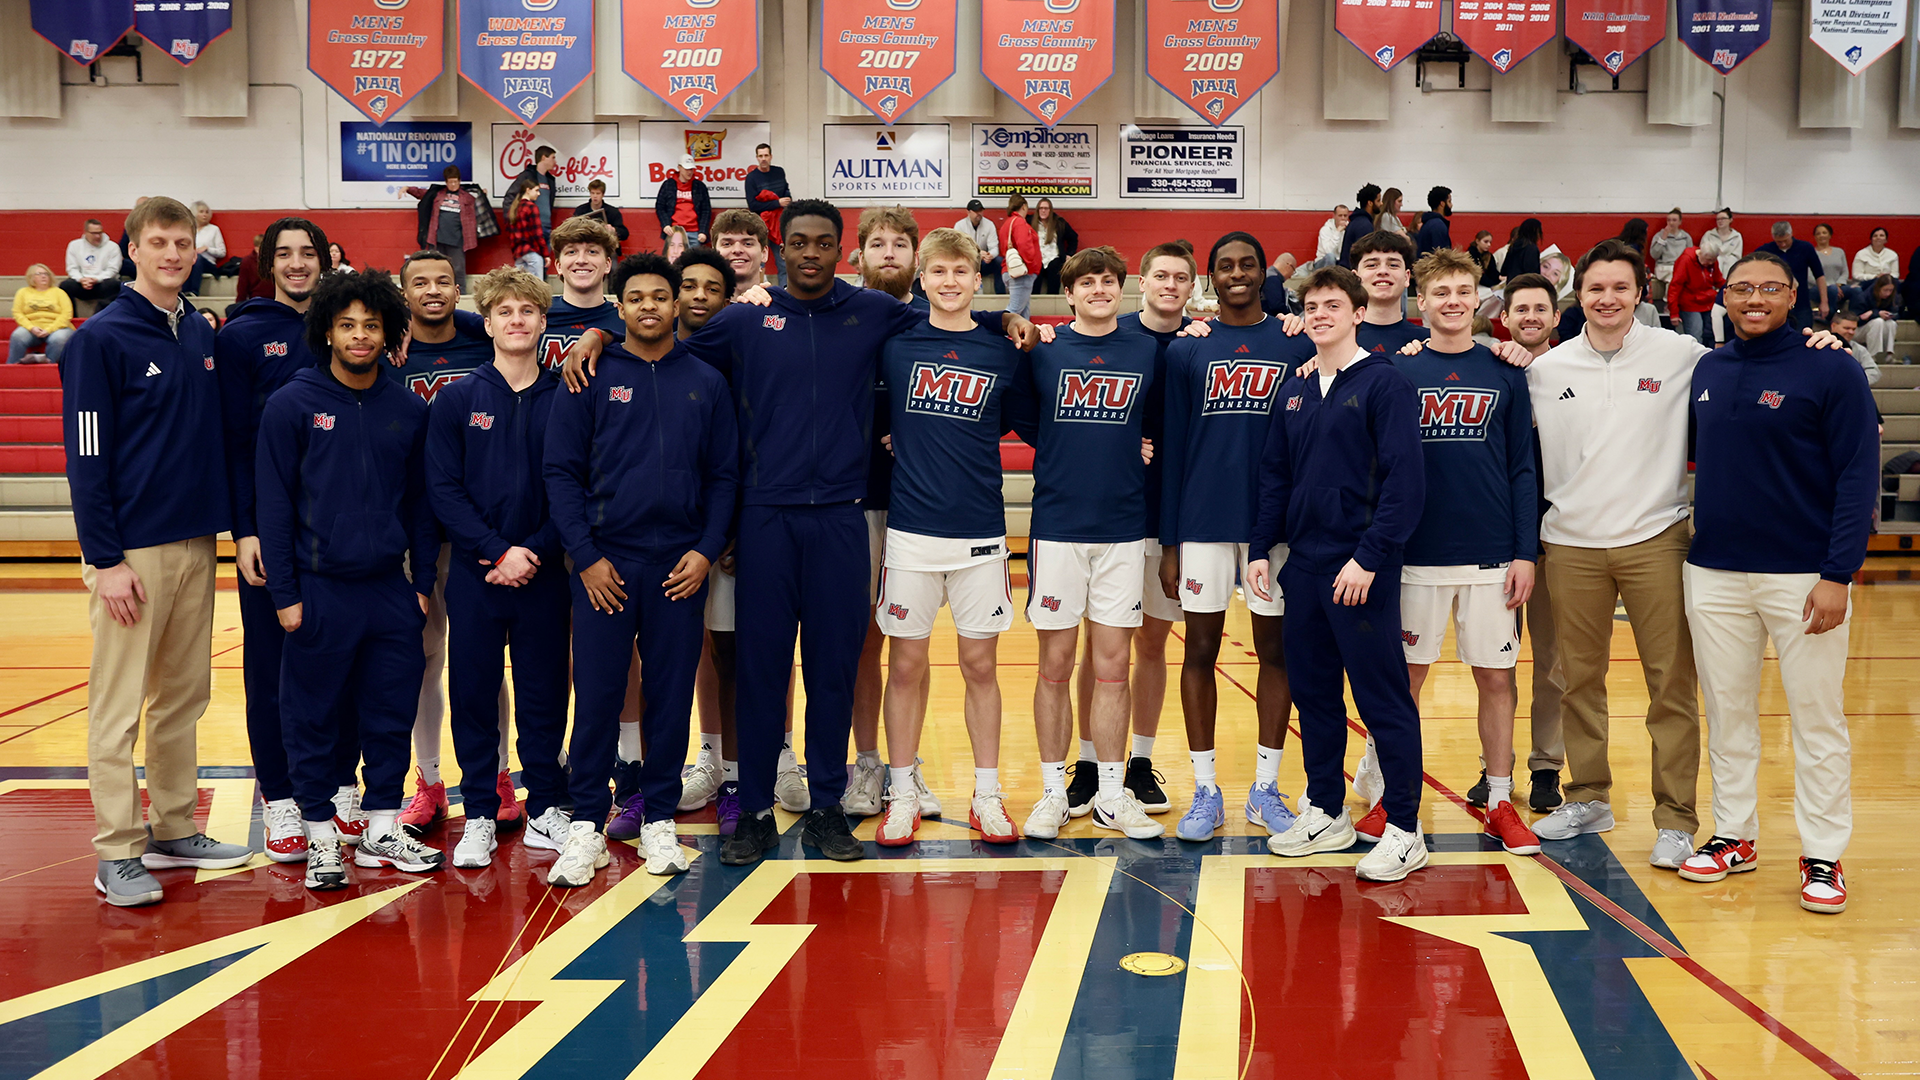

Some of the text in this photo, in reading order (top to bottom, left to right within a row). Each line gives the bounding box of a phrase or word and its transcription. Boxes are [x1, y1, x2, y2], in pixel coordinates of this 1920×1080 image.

[351, 16, 404, 29] MEN'S
[664, 14, 716, 28] MEN'S
[862, 16, 916, 30] MEN'S
[1582, 12, 1650, 22] NAIA Champions
[1849, 10, 1881, 19] Division
[488, 18, 566, 31] WOMEN'S
[1022, 20, 1074, 33] MEN'S
[1186, 19, 1238, 33] MEN'S
[328, 30, 427, 48] Cross Country
[476, 33, 577, 48] Cross Country
[676, 30, 706, 43] Golf
[840, 30, 938, 48] Cross Country
[998, 34, 1097, 51] Cross Country
[1164, 34, 1261, 49] Cross Country
[70, 40, 98, 59] MU
[171, 39, 199, 59] MU
[660, 48, 722, 68] 2000
[350, 50, 406, 68] 1972
[500, 51, 557, 70] 1999
[858, 50, 920, 69] 2007
[1017, 53, 1078, 72] 2008
[1184, 52, 1244, 72] 2009
[1712, 49, 1737, 68] MU
[354, 76, 402, 97] NAIA
[504, 78, 553, 98] NAIA
[669, 75, 718, 96] NAIA
[864, 76, 912, 97] NAIA
[1024, 79, 1072, 100] NAIA
[1191, 78, 1238, 99] NAIA
[356, 132, 456, 141] NATIONALLY RENOWNED
[1129, 132, 1156, 140] Mortgage
[357, 142, 456, 163] #1 IN OHIO
[1130, 146, 1232, 159] PIONEER
[832, 159, 942, 178] AULTMAN
[832, 182, 942, 190] SPORTS MEDICINE
[763, 314, 786, 330] MU
[263, 341, 288, 357] MU
[203, 356, 215, 371] U
[912, 367, 990, 406] MU
[1061, 374, 1137, 409] MU
[1208, 365, 1281, 401] MU
[1637, 378, 1661, 393] MU
[609, 385, 633, 403] MU
[1757, 389, 1786, 409] MU
[911, 401, 978, 416] PIONEERS
[1060, 410, 1124, 419] PIONEERS
[1205, 401, 1268, 410] PIONEERS
[1420, 392, 1494, 427] MU
[313, 412, 336, 431] MU
[469, 411, 495, 430] MU
[1186, 578, 1203, 595] MU
[888, 603, 909, 620] MU
[1040, 596, 1061, 612] MU
